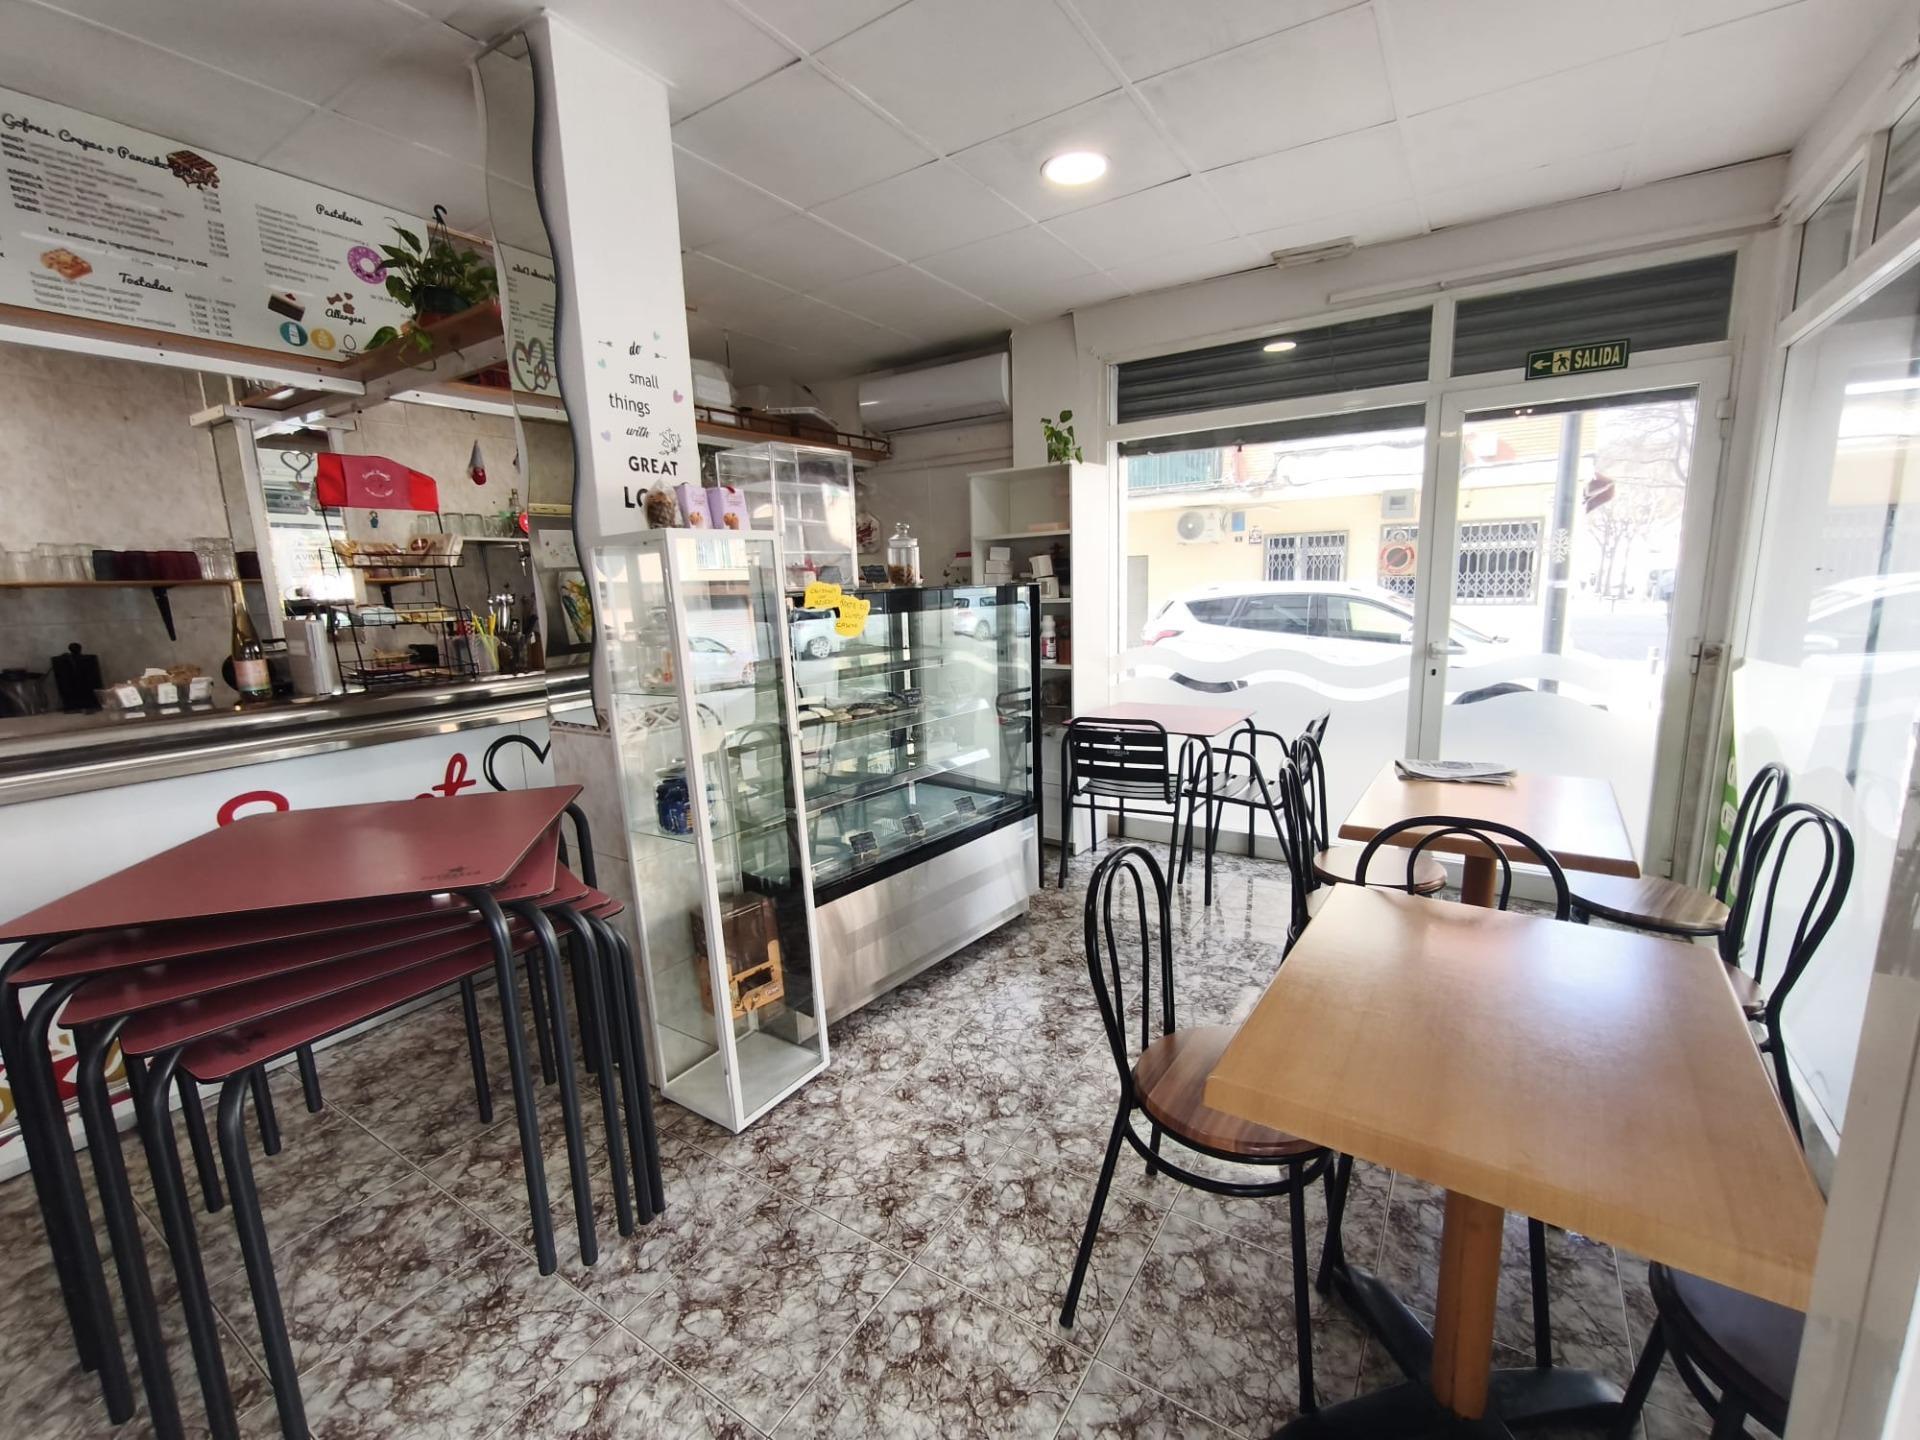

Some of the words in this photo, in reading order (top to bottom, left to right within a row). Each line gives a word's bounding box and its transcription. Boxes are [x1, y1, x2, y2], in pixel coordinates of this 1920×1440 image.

[118, 271, 173, 293] Tostadas
[629, 341, 642, 356] do
[1574, 345, 1620, 369] SALIDA
[629, 373, 659, 389] small
[609, 393, 651, 418] things
[625, 425, 649, 438] with
[628, 455, 678, 476] GREAT
